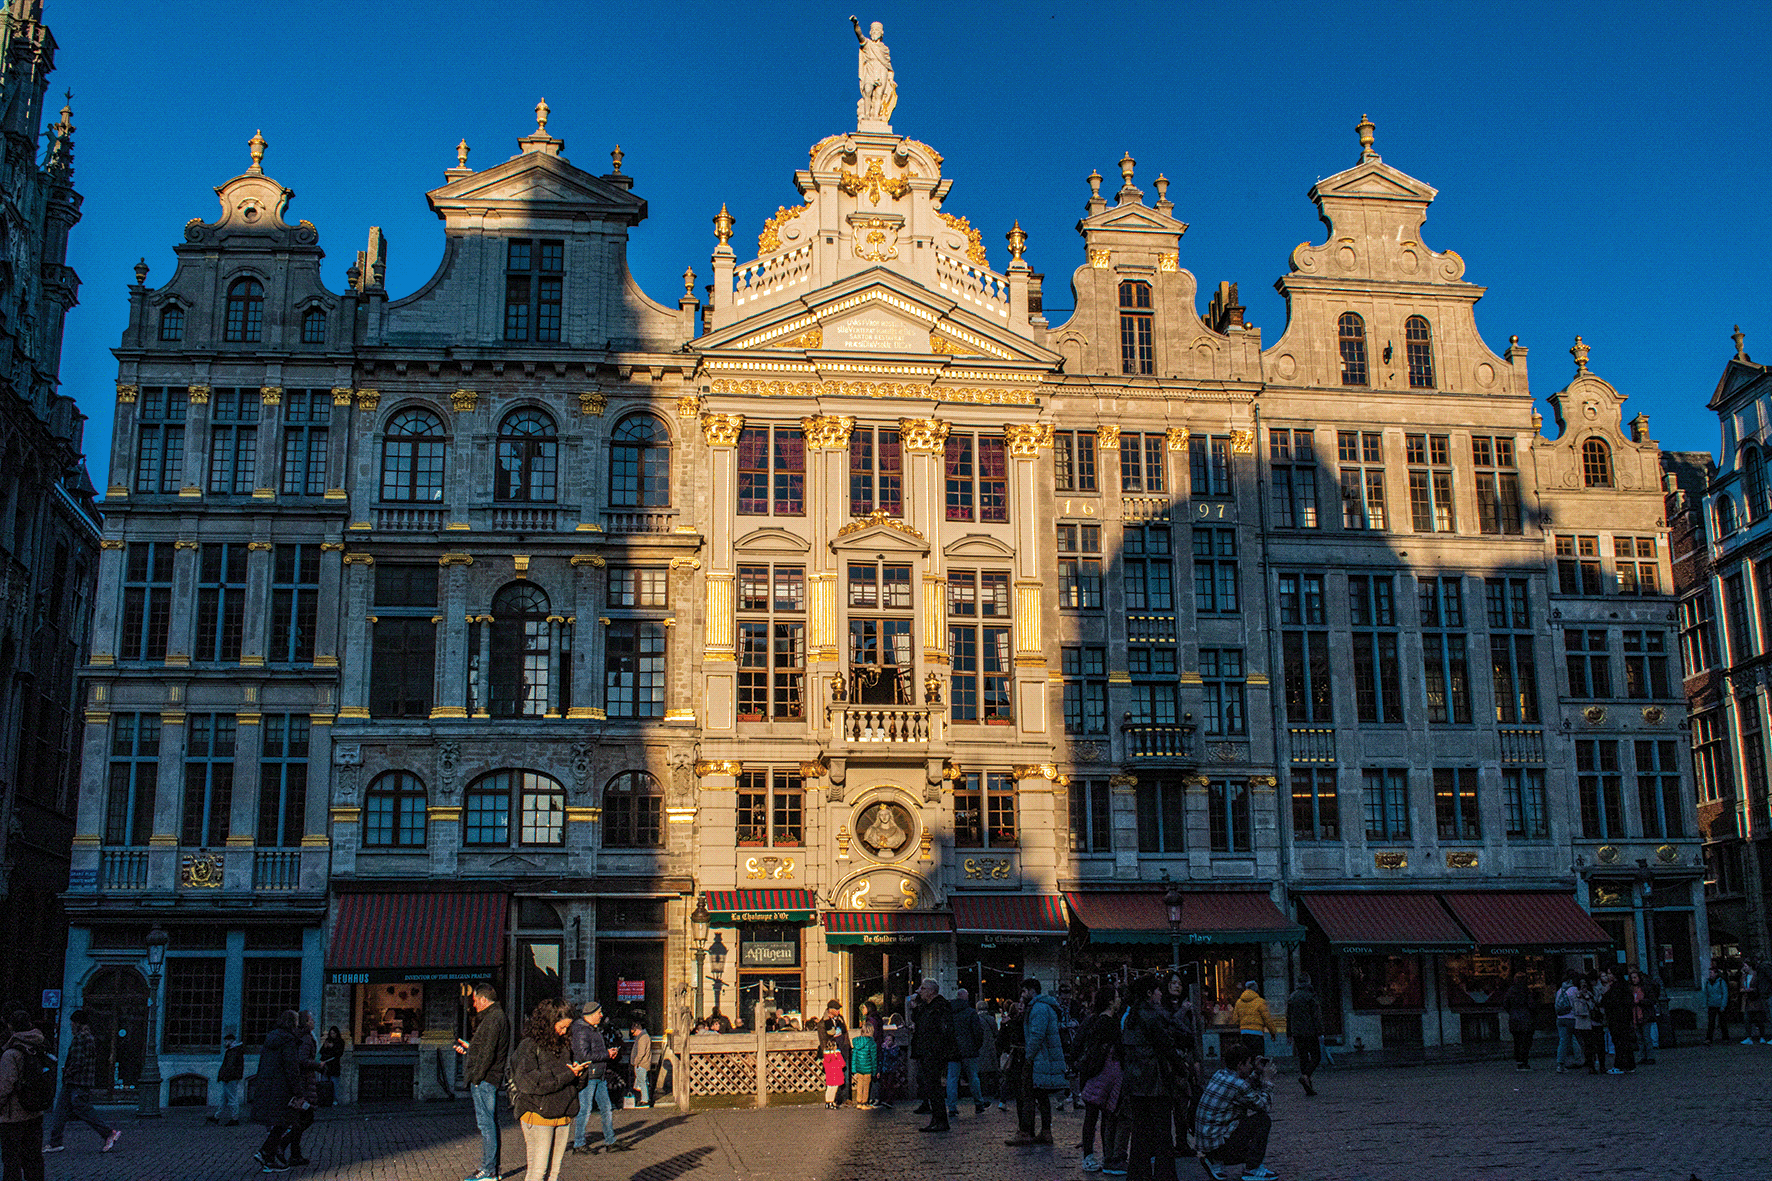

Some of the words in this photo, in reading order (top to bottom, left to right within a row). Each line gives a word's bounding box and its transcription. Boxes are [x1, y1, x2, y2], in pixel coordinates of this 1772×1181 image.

[731, 912, 741, 921] La
[741, 912, 773, 922] Chaloupe
[863, 935, 873, 943] De
[873, 934, 897, 943] Gulden
[1188, 932, 1213, 944] Mary
[744, 947, 793, 962] Affligem
[1342, 946, 1374, 954] GODIVA
[1490, 947, 1521, 955] GODIVA
[332, 973, 370, 984] NEUHAUS
[470, 972, 492, 980] PRALINE
